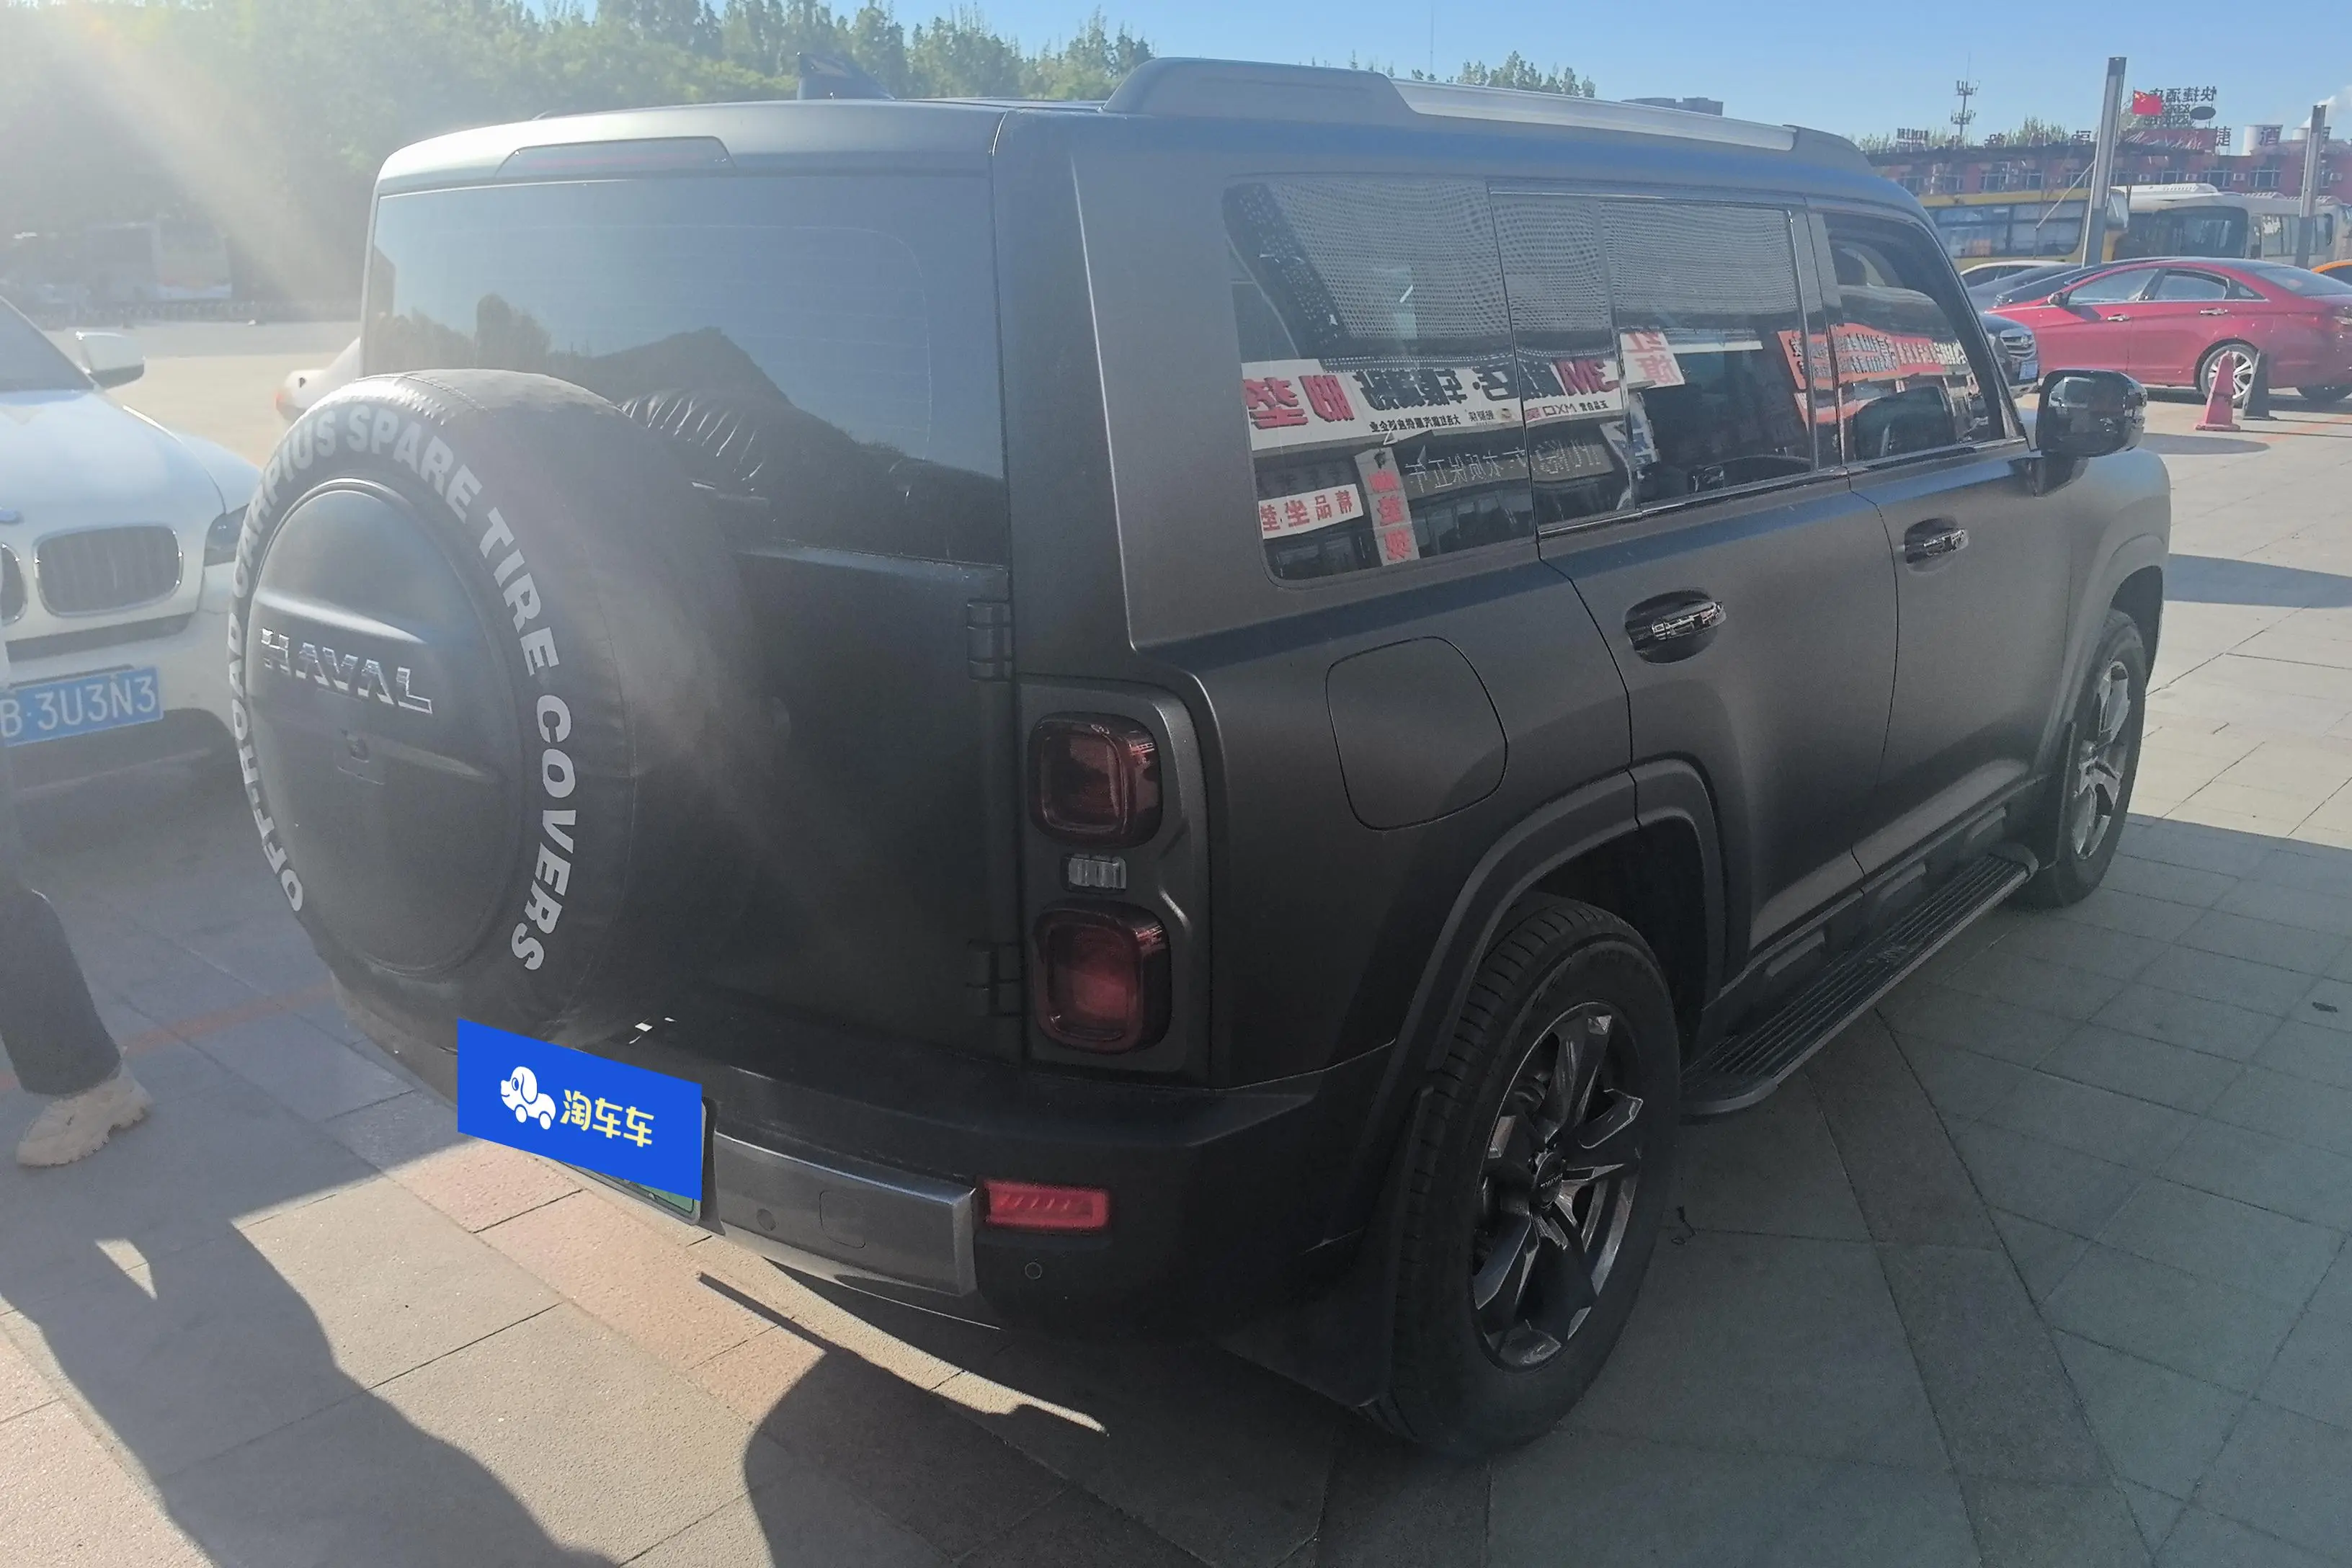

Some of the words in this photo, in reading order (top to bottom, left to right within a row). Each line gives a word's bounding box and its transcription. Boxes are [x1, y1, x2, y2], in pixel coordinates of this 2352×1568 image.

[346, 404, 483, 524] SPARE
[479, 507, 560, 677] TIRE
[261, 628, 433, 714] HAVAL
[511, 694, 576, 971] COVERS
